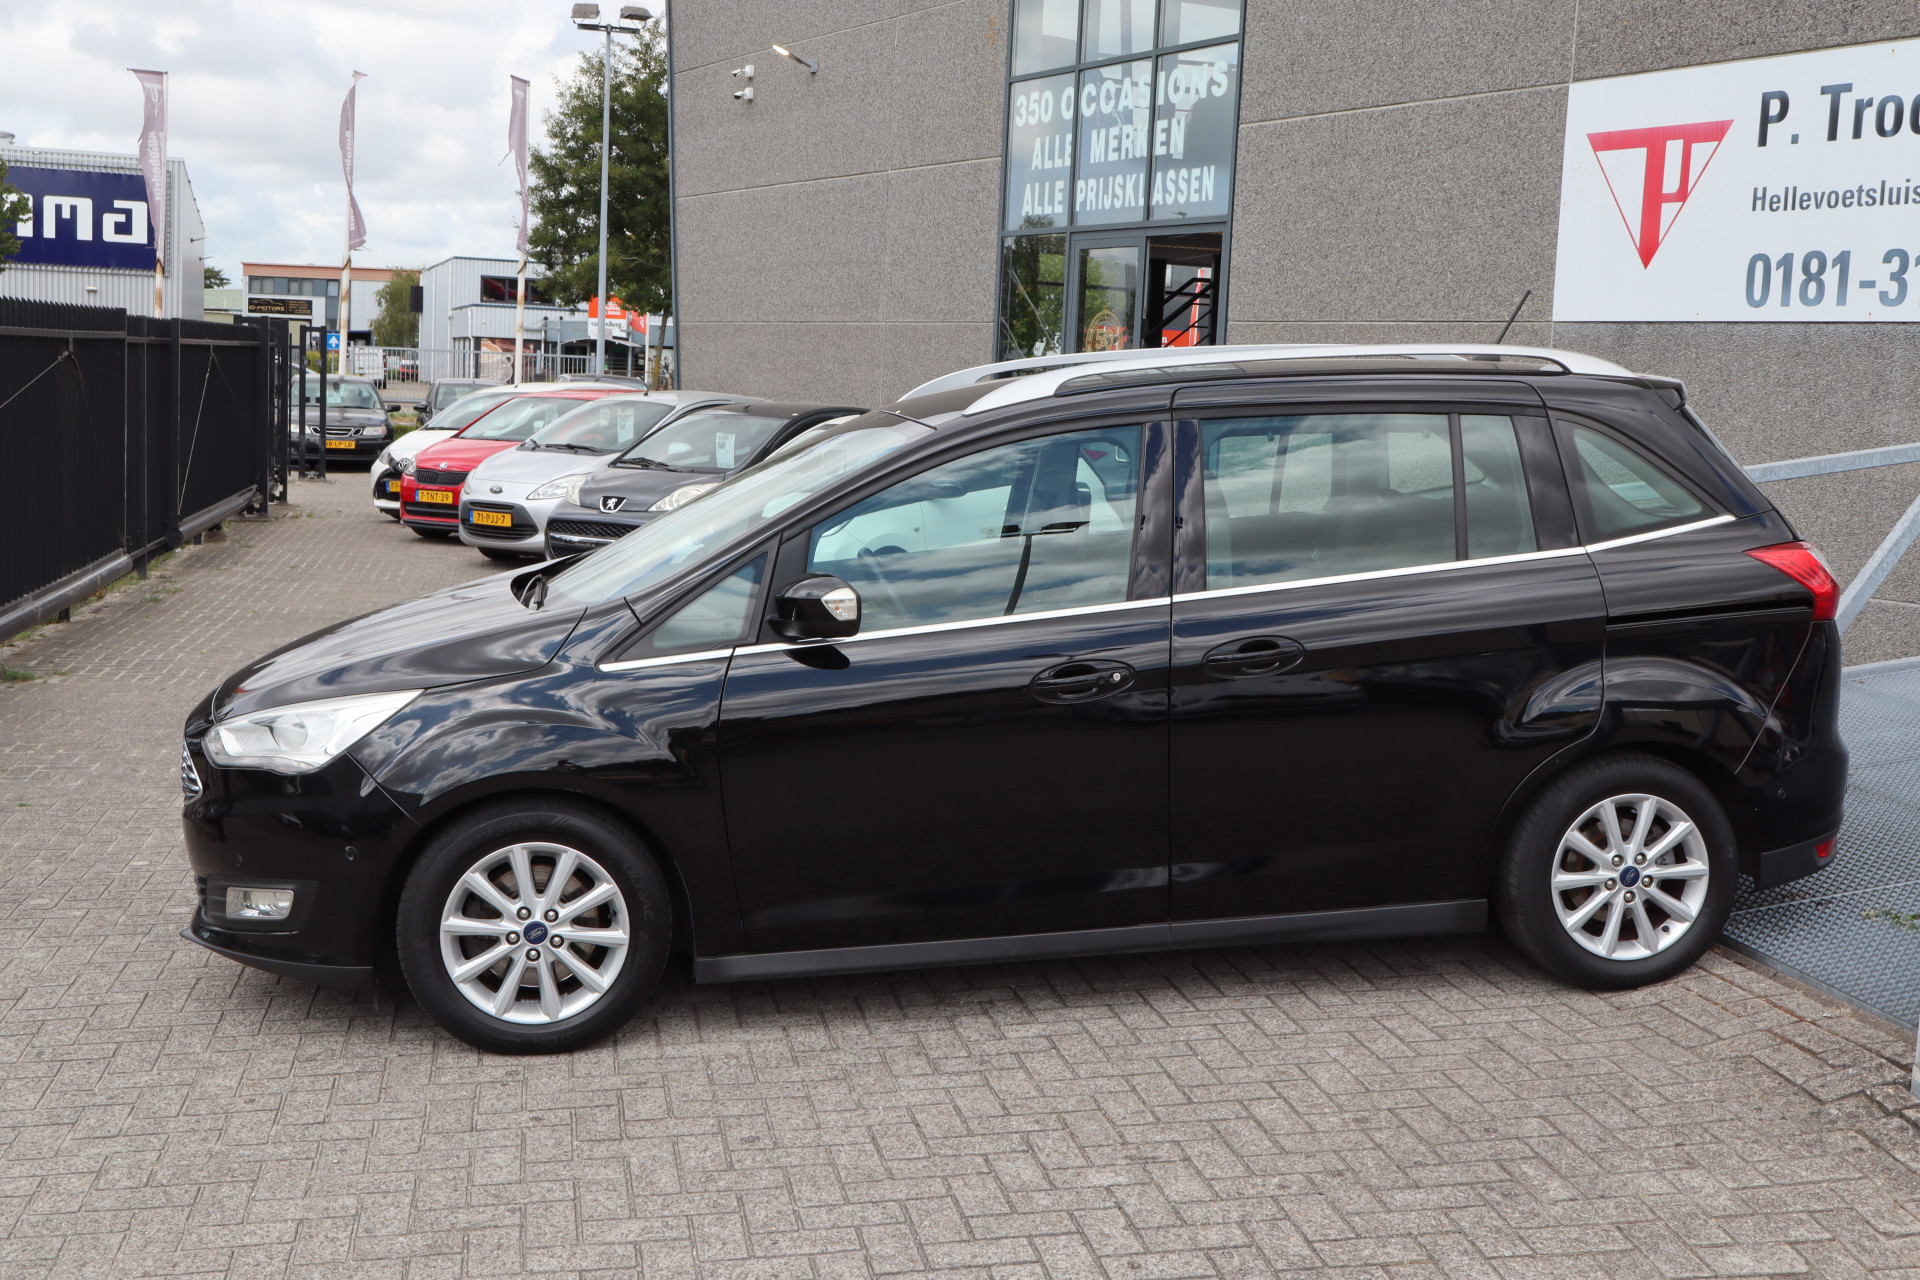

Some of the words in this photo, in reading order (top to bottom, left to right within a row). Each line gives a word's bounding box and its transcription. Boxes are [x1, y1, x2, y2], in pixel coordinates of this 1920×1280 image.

[1015, 90, 1053, 127] 350
[1061, 60, 1229, 120] OCCASIONS
[1757, 90, 1799, 147] P.
[1031, 133, 1072, 170] ALLE
[1090, 118, 1185, 164] MERKEN
[1022, 180, 1064, 216] ALLE
[1076, 165, 1215, 212] PRIJSKLASSEN
[1745, 248, 1920, 308] 0181-3
[420, 491, 449, 502] 7-TNT-39
[477, 512, 506, 525] 71-PJJ-7
